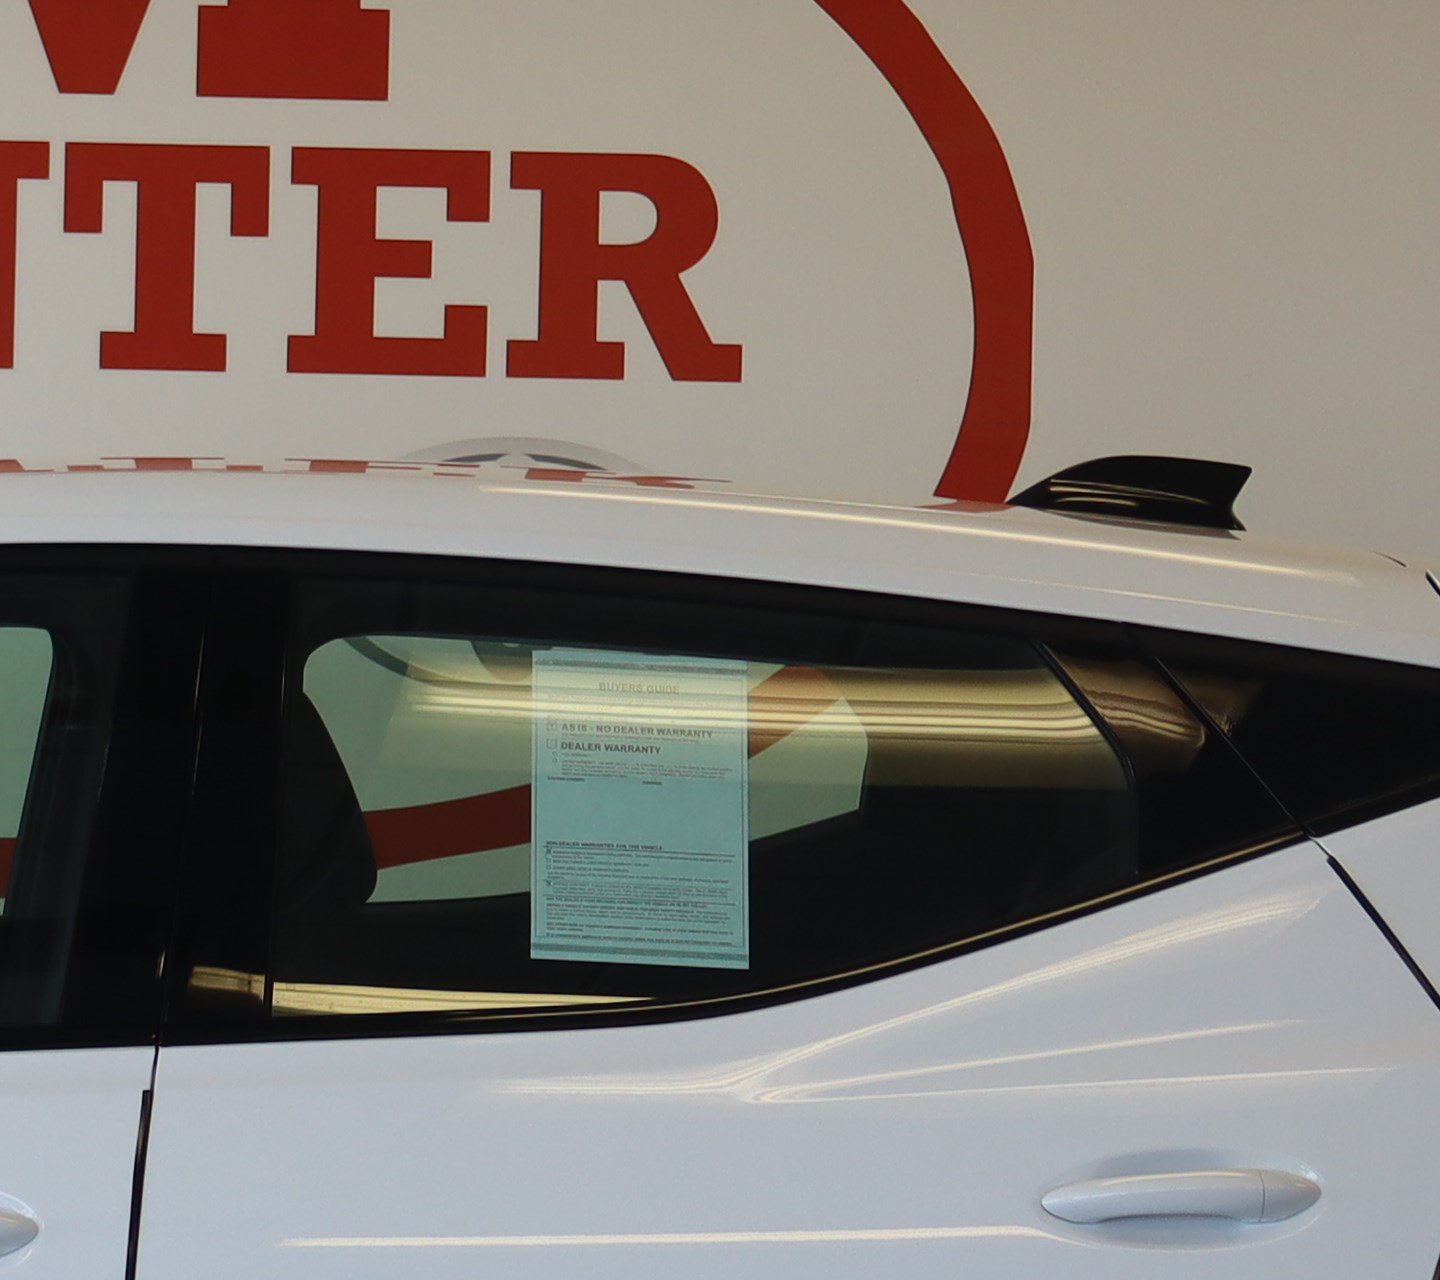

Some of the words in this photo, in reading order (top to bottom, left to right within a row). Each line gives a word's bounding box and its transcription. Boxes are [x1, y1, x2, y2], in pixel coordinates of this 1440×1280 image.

[598, 681, 642, 694] BUYERS
[646, 684, 680, 696] GUIDE
[561, 723, 576, 732] AS
[596, 724, 611, 734] NO
[613, 725, 654, 736] DEALER
[656, 727, 713, 739] WARRANTY
[560, 741, 601, 752] DEALER
[604, 742, 662, 755] WARRANTY
